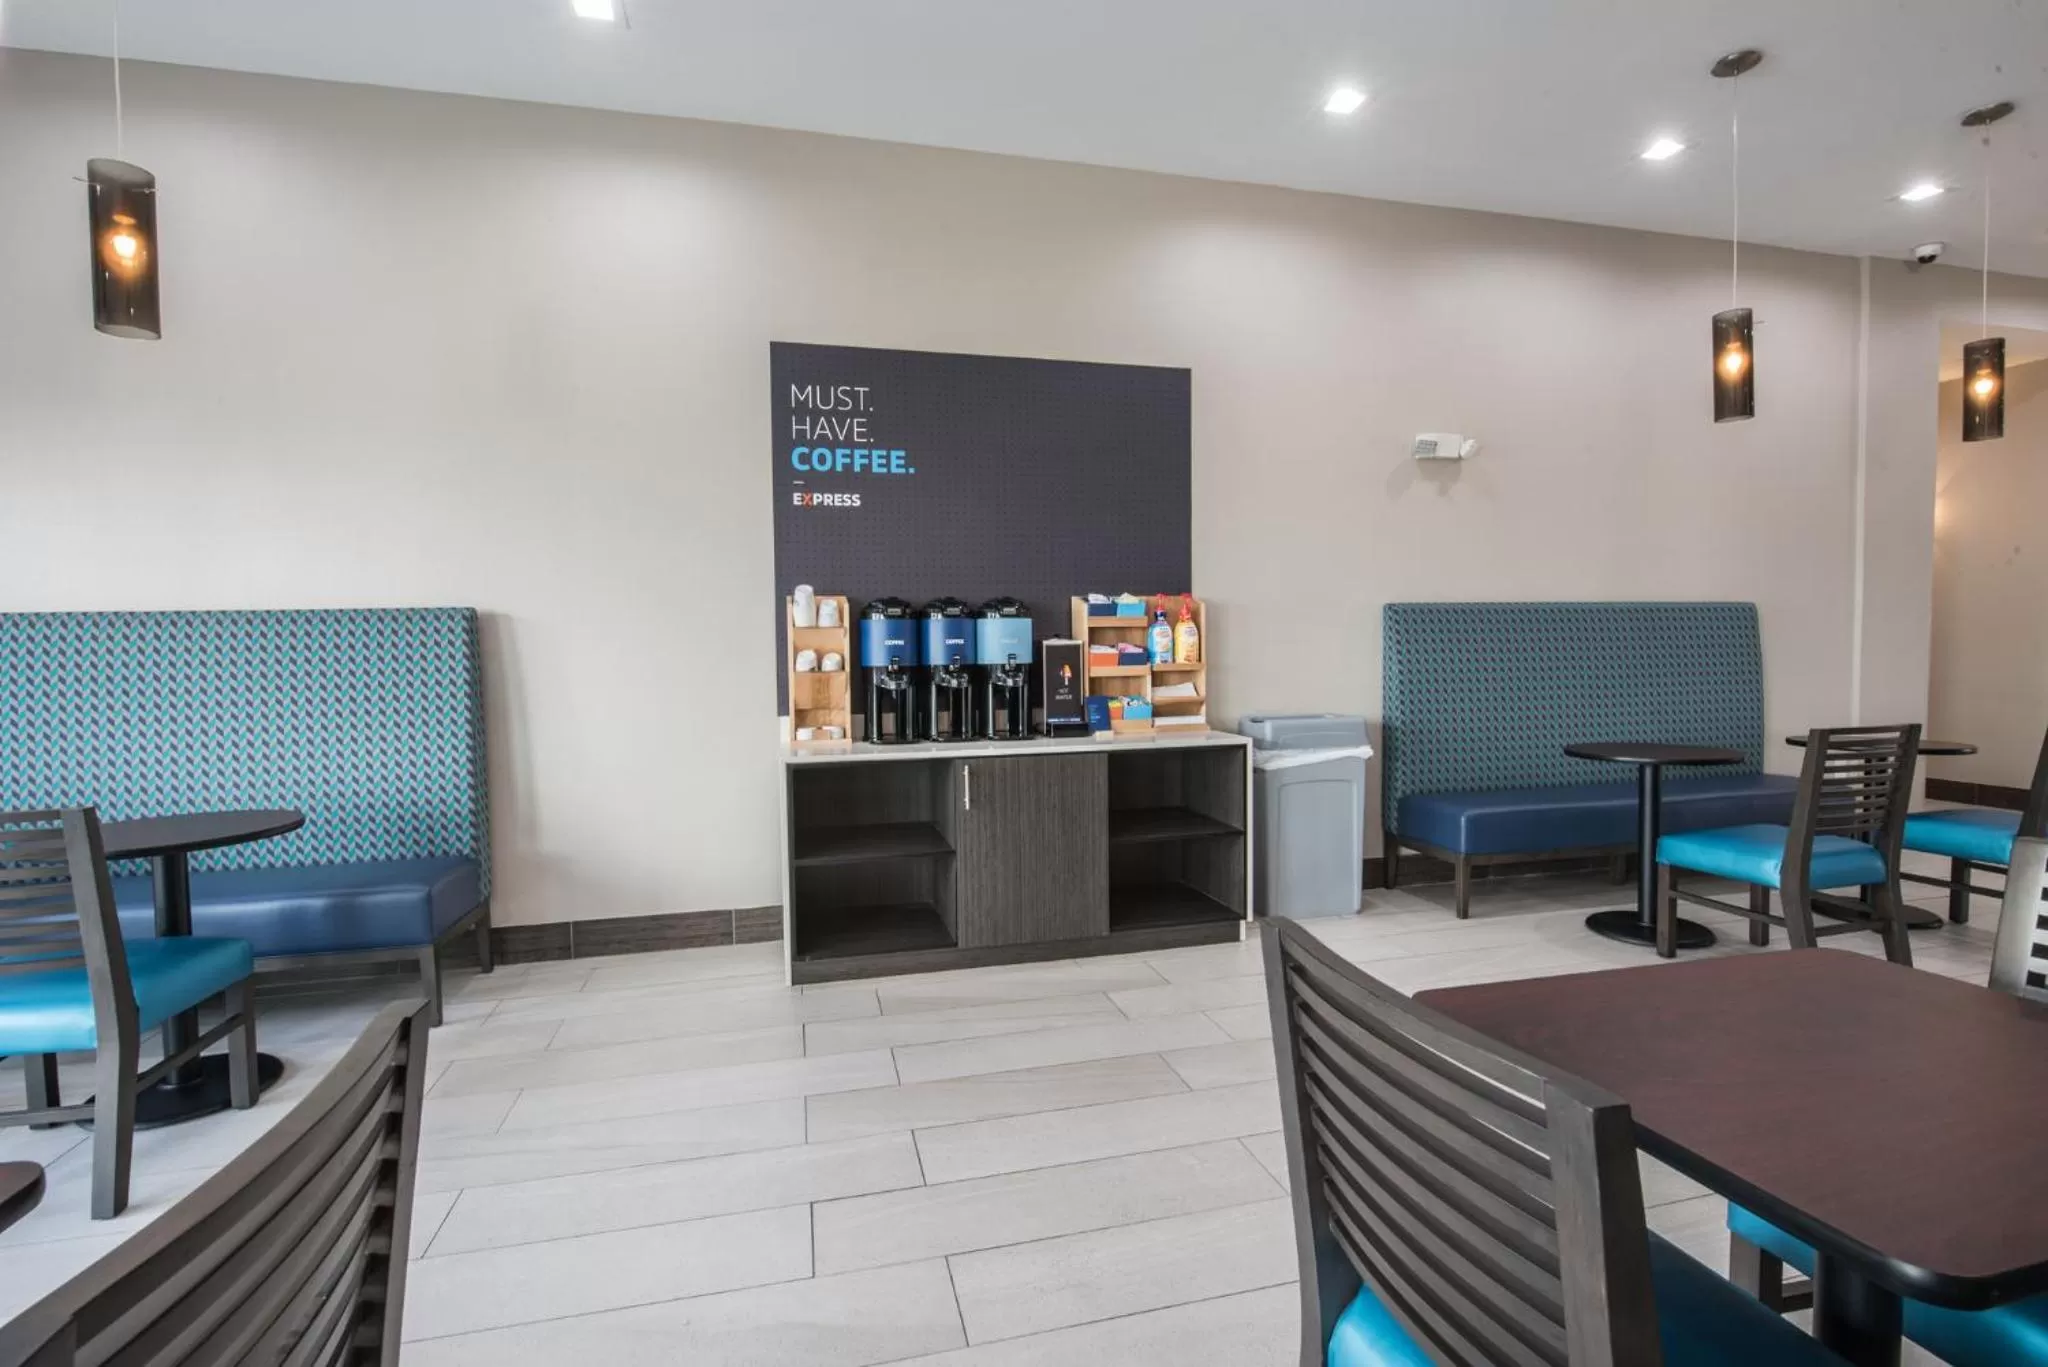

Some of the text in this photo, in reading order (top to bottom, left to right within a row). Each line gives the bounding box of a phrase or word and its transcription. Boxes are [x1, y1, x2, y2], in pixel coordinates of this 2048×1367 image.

[791, 384, 873, 411] MUST.
[792, 415, 874, 442] HAVE.
[791, 446, 915, 474] COFFEE.
[793, 490, 861, 508] EXPRESS
